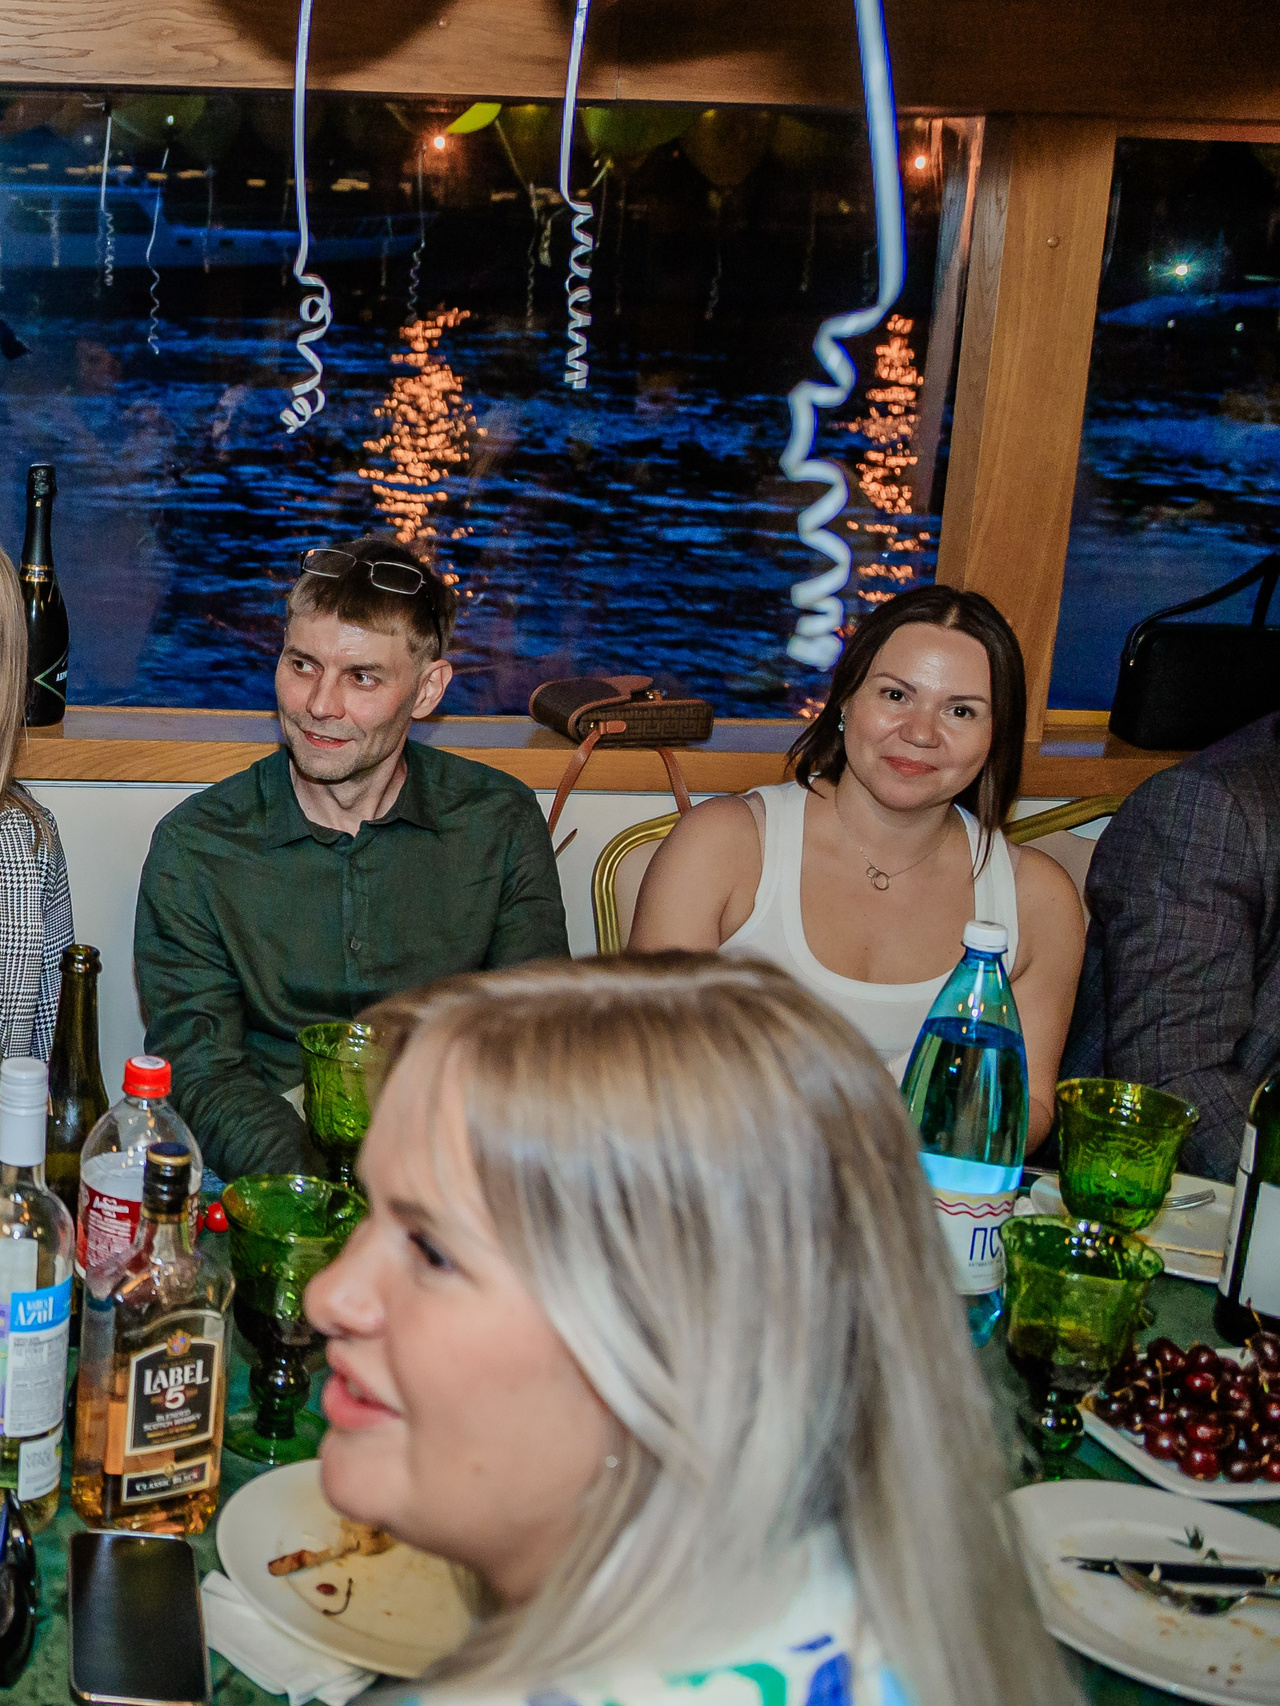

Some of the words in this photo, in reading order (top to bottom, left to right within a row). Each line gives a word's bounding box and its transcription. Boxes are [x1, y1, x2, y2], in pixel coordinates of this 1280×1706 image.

[969, 1226, 1000, 1260] ПС
[14, 1296, 54, 1326] Azul
[143, 1359, 210, 1395] LABEL
[165, 1385, 185, 1409] 5
